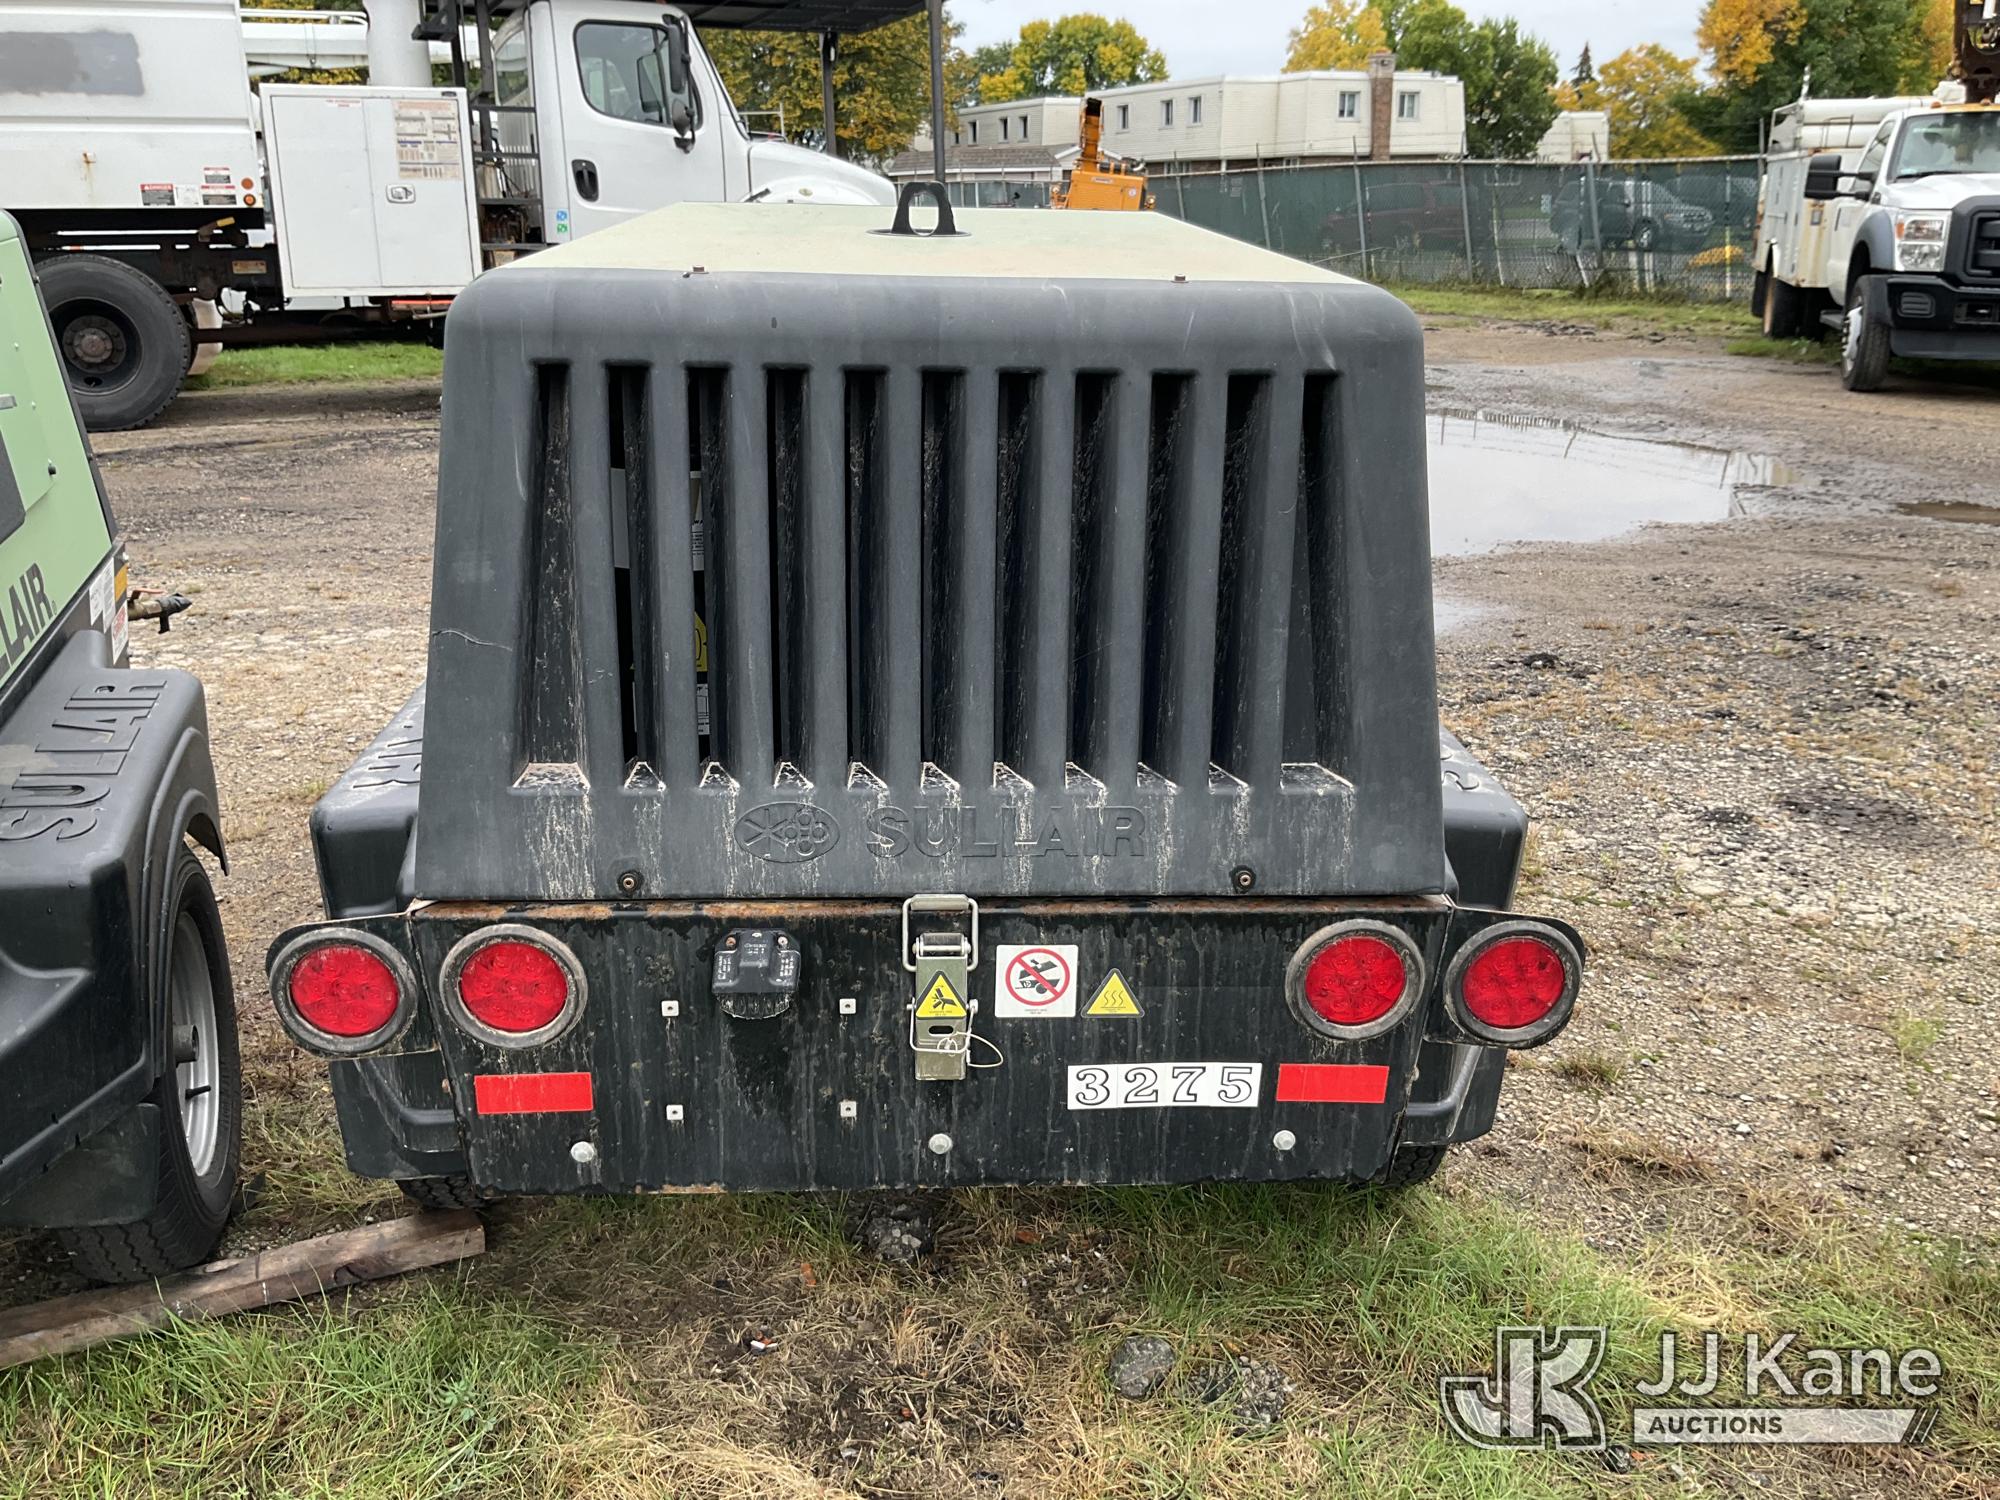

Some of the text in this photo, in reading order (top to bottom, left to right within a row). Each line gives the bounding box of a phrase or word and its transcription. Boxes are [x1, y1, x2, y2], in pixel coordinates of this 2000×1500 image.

[0, 563, 53, 680] LAIR
[0, 681, 167, 841] SULLAIR
[866, 805, 1146, 858] SULLAIR
[1075, 1066, 1253, 1106] 3275
